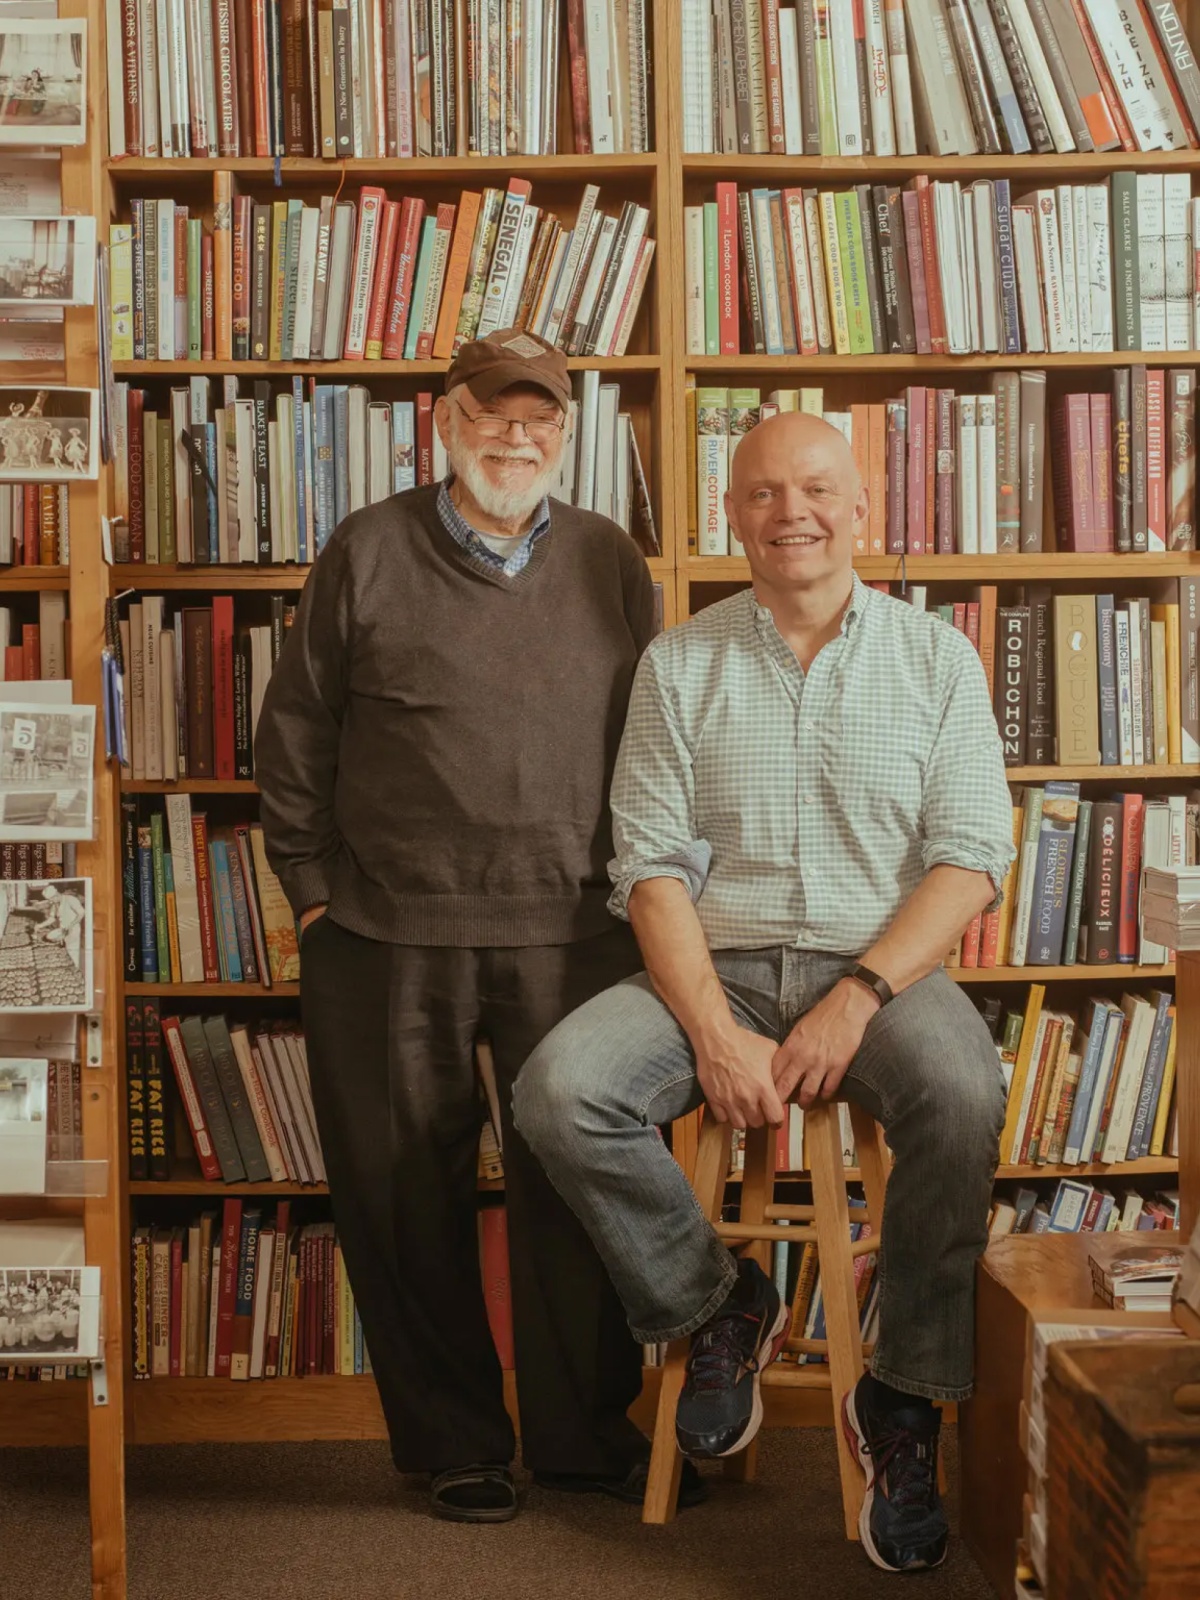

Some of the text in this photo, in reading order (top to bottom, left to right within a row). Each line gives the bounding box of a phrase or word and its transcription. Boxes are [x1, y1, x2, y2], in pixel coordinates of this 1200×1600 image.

[338, 26, 346, 45] Pastry
[1119, 9, 1157, 90] BREIZH
[128, 51, 137, 104] VITRINES
[220, 47, 233, 131] CHOCOLATIER
[580, 193, 596, 224] TASTES
[1122, 190, 1130, 215] SALLY
[316, 225, 330, 282] TAKEAWAY
[475, 247, 487, 273] FROM
[490, 203, 521, 283] SENEGAL
[566, 239, 583, 270] AFRICA
[997, 205, 1014, 289] sugar club
[1123, 217, 1132, 251] CLARKE
[135, 243, 143, 309] STREET FOOD
[145, 255, 155, 289] MARCUS
[205, 270, 213, 296] STREET
[234, 224, 243, 301] STREET FOOD
[358, 218, 374, 309] The Old World Kitchen
[435, 253, 445, 282] AFRICA
[724, 234, 732, 319] London COOKBOOK
[146, 290, 156, 344] SAMUELSSON
[468, 274, 481, 309] ACROSS
[750, 281, 759, 321] COOKBOOK
[1124, 270, 1134, 331] INGREDIENTS
[370, 304, 384, 337] cooking
[257, 399, 267, 436] BLAKE'S
[1135, 384, 1144, 432] FEASTING
[1147, 380, 1160, 479] CLASSIC KOFFMANN
[130, 444, 141, 484] FOOD
[258, 440, 267, 468] FEAST
[421, 448, 429, 471] MATT
[1118, 420, 1130, 474] chefs
[43, 495, 55, 538] TABLE
[132, 499, 142, 543] OMAN
[1036, 604, 1047, 705] French Regional Food
[1101, 608, 1112, 667] bistronomy
[1119, 622, 1127, 676] FRENCHIE
[142, 852, 151, 879] Morgan
[194, 824, 207, 878] SWEET HANDS
[1053, 838, 1069, 908] GLORIOUS
[1172, 835, 1181, 864] LITTLE
[143, 880, 151, 911] Freeman
[1040, 838, 1059, 935] FRENCH FOOD
[1100, 839, 1115, 917] DÉLICIEUX
[145, 920, 153, 947] Friends
[129, 1079, 145, 1156] FAT RICE
[149, 1079, 166, 1156] FAT RICE
[1134, 1081, 1154, 1136] PROVENCE
[243, 1228, 257, 1300] HOME FOOD
